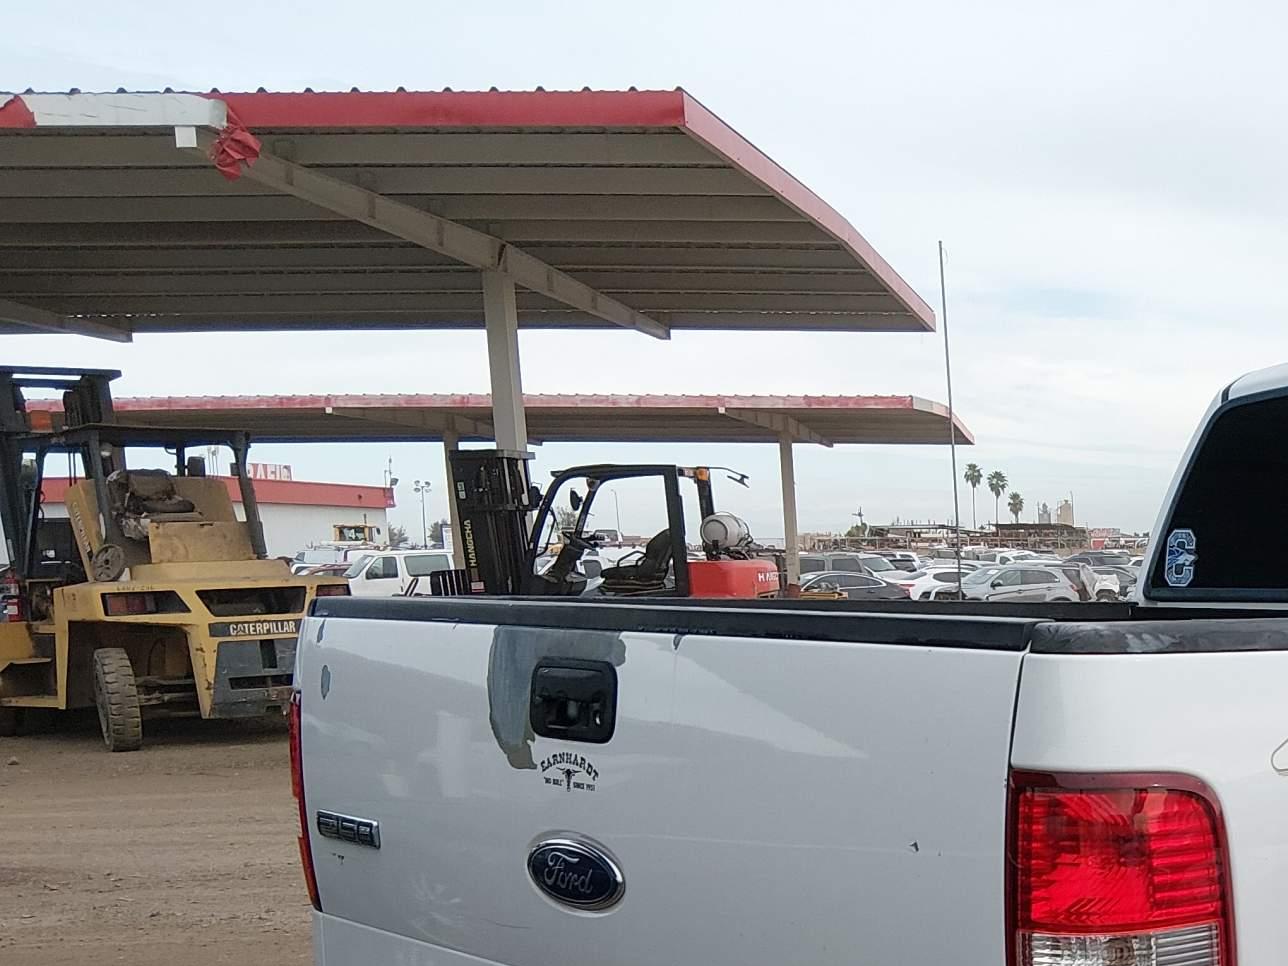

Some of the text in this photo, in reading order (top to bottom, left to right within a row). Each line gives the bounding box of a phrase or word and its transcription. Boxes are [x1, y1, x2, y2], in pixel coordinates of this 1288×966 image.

[464, 519, 477, 567] HANGCHA
[229, 620, 296, 636] CATERPILLAR
[540, 751, 599, 782] EARNHARDT
[544, 851, 593, 893] Ford
